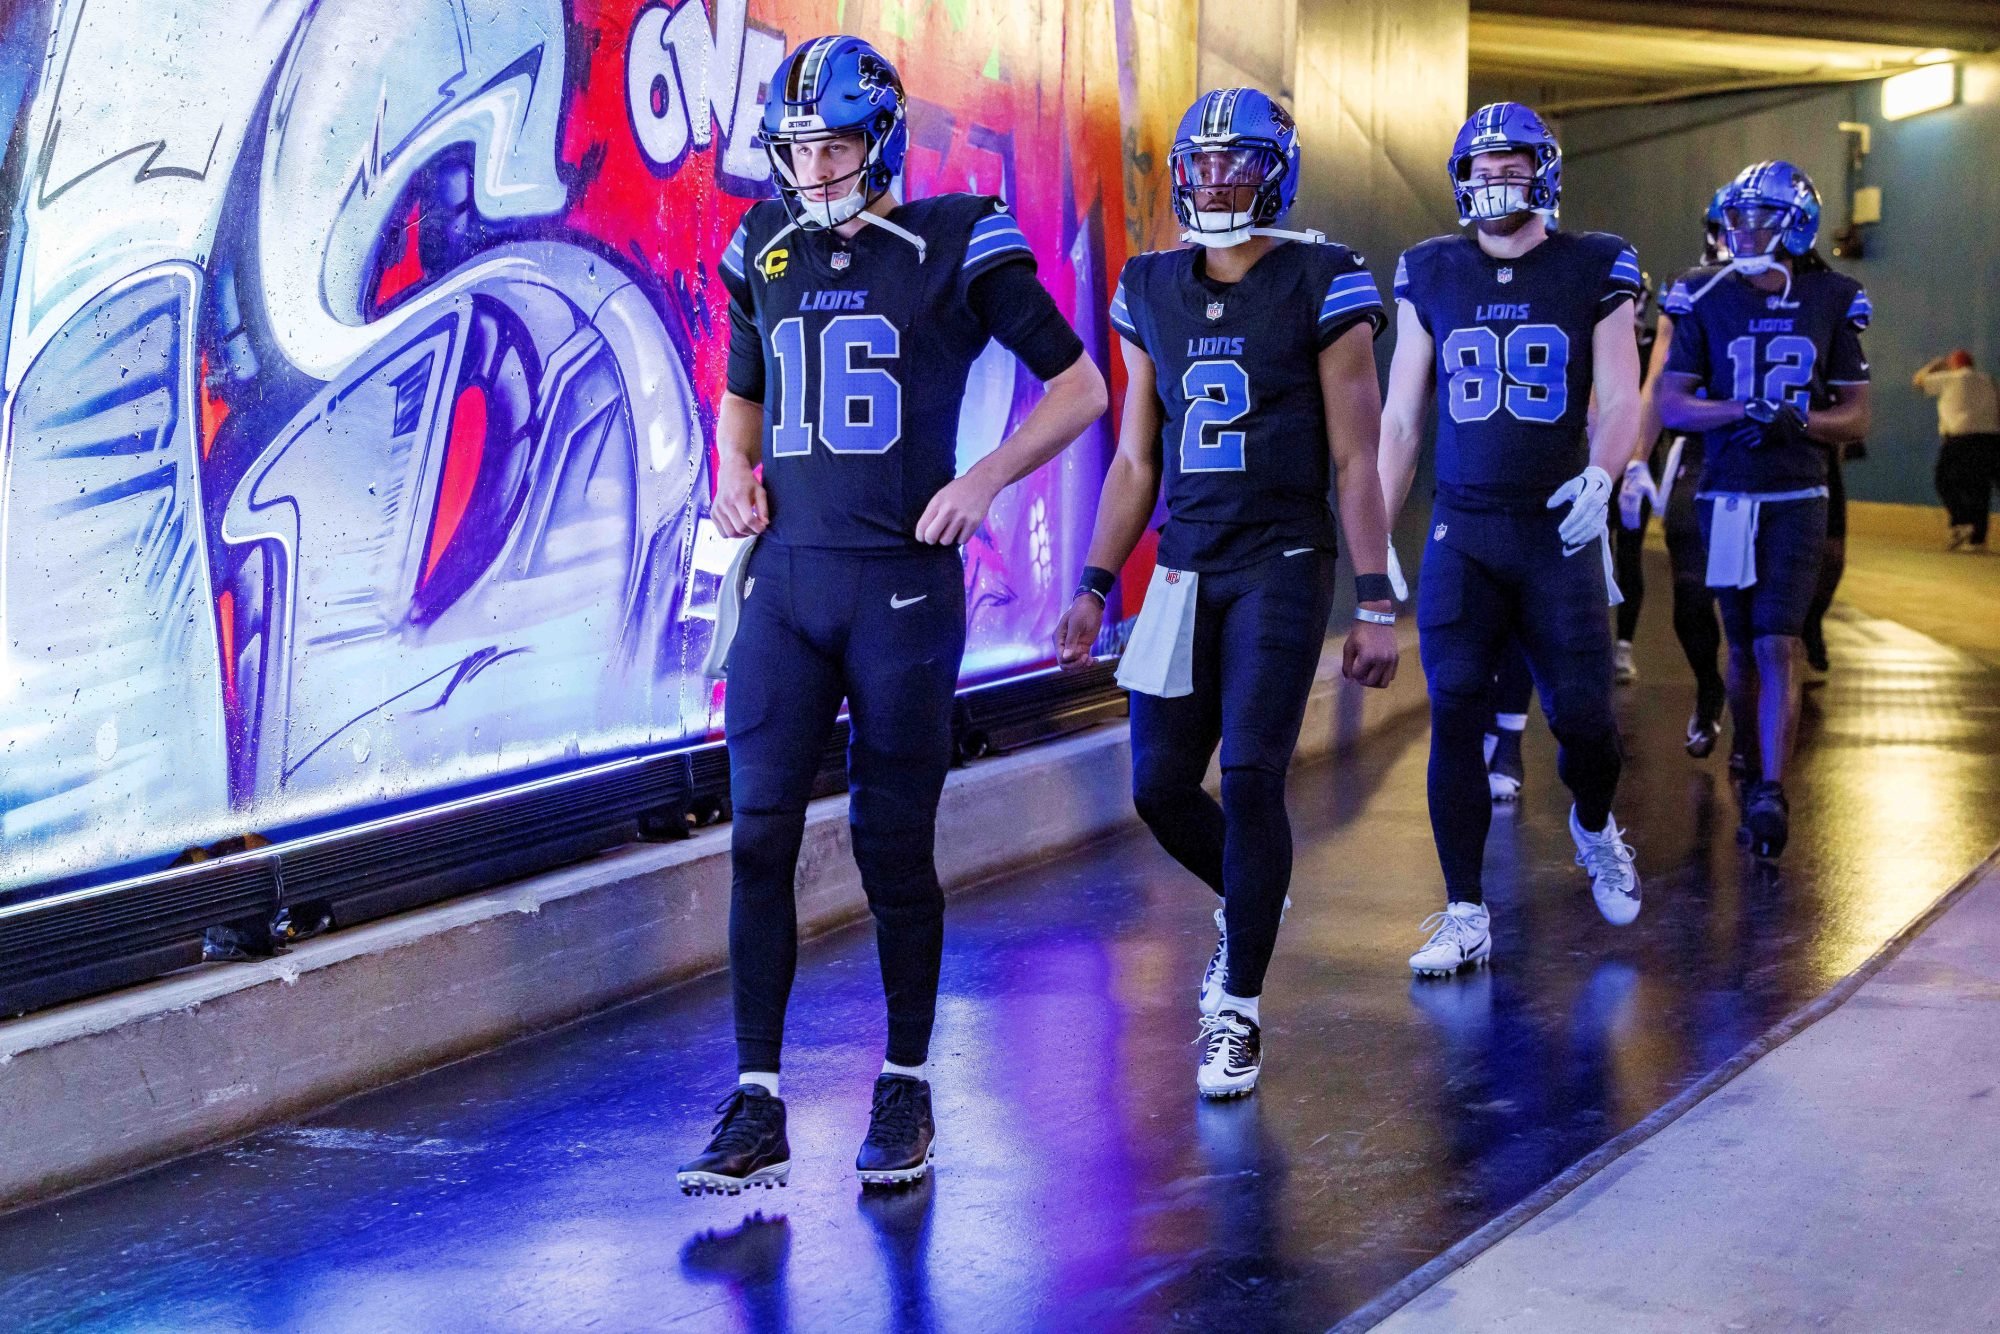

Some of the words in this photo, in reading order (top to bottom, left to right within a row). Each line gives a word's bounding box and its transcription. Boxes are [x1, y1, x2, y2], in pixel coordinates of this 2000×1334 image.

[624, 0, 786, 198] ONE
[788, 119, 812, 128] DETROIT
[765, 248, 789, 275] C
[770, 314, 901, 457] 16
[1180, 359, 1250, 473] 2
[1442, 324, 1569, 423] 89
[1727, 335, 1817, 415] 12
[1167, 572, 1179, 583] NFL
